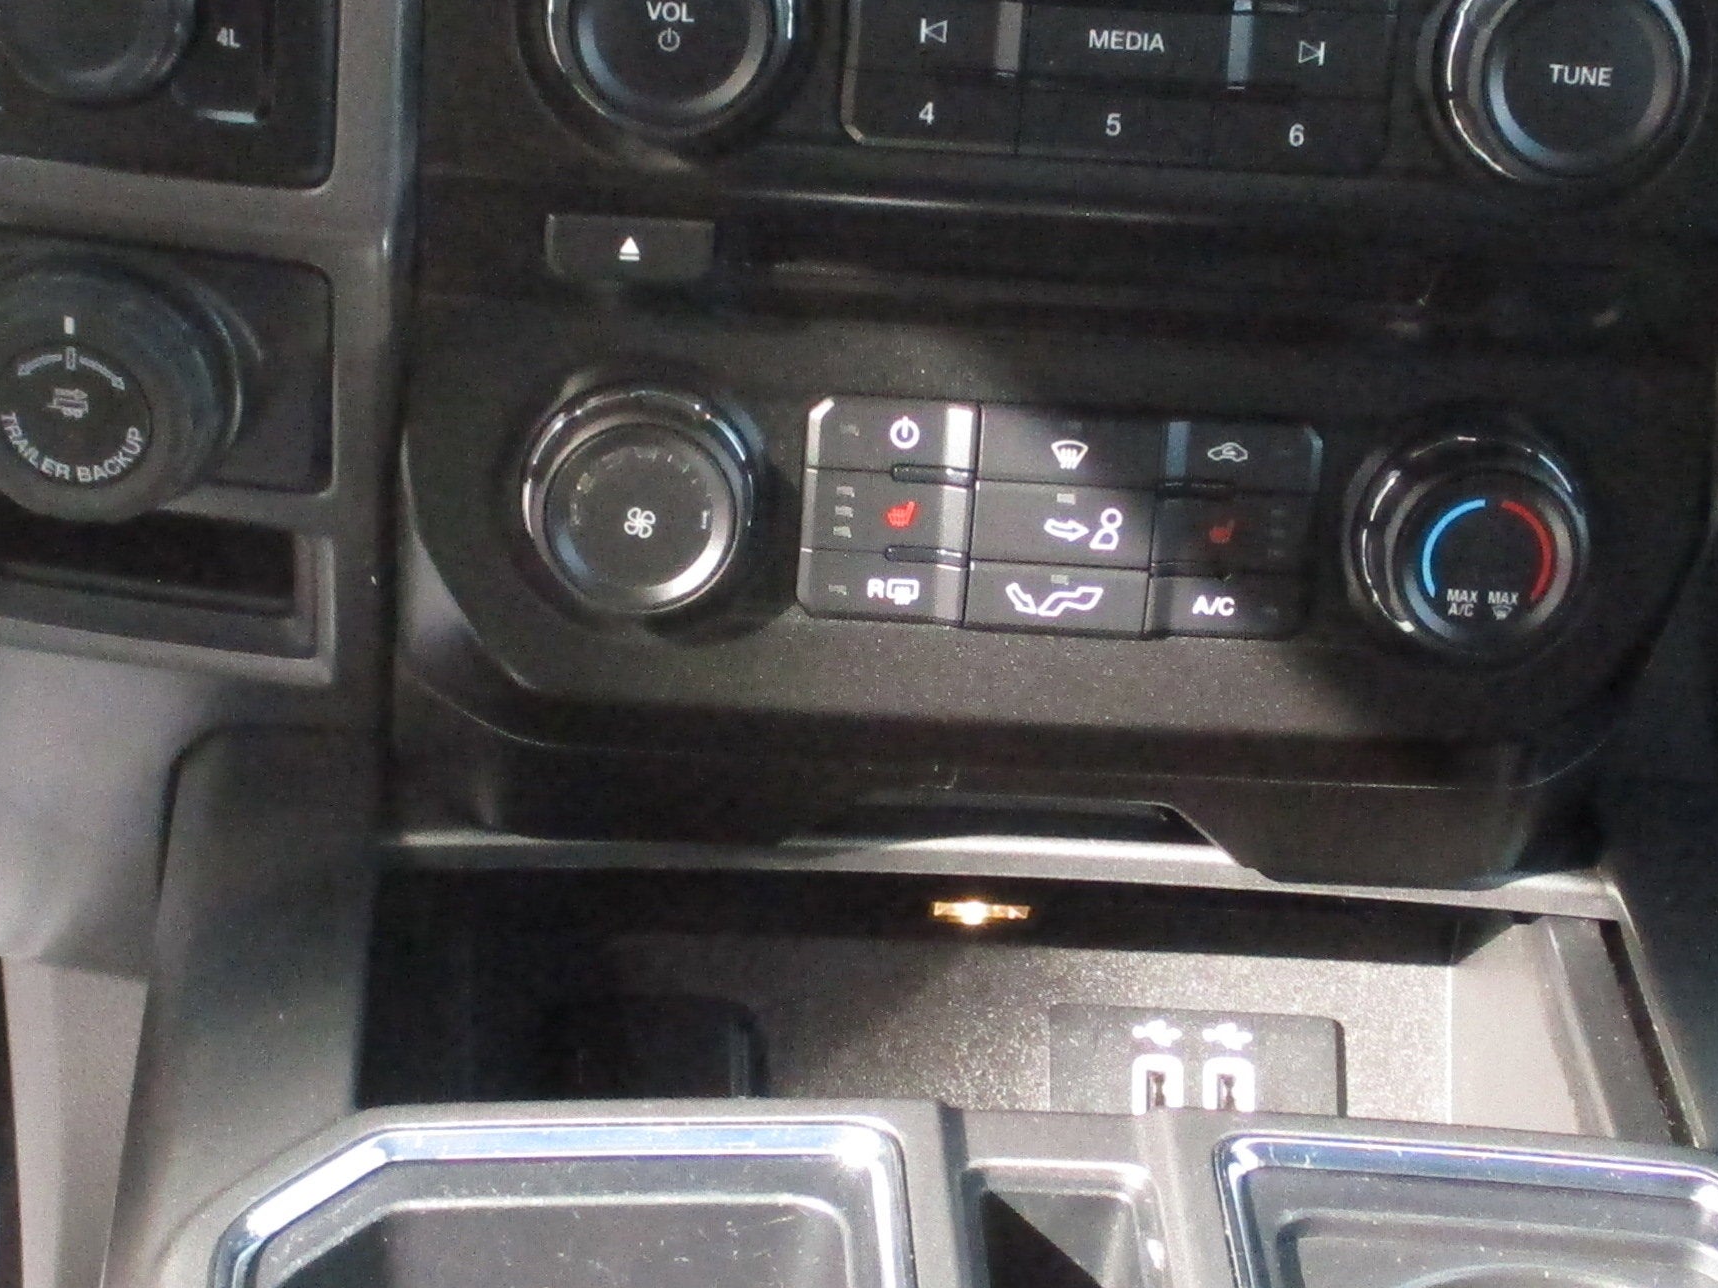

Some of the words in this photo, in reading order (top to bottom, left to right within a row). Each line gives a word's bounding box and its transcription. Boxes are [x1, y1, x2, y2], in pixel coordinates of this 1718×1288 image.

[645, 1, 695, 25] VOL
[216, 27, 241, 49] 4L
[1088, 28, 1165, 52] MEDIA
[1549, 63, 1612, 87] TUNE
[918, 101, 935, 124] 4
[1105, 112, 1122, 137] 5
[1288, 123, 1305, 147] 6
[0, 411, 72, 482] TRAILER
[75, 425, 146, 485] BACKUP
[1191, 595, 1234, 617] A/C
[1446, 588, 1478, 603] MAX
[1487, 590, 1518, 605] MAX
[1448, 599, 1477, 617] A/C
